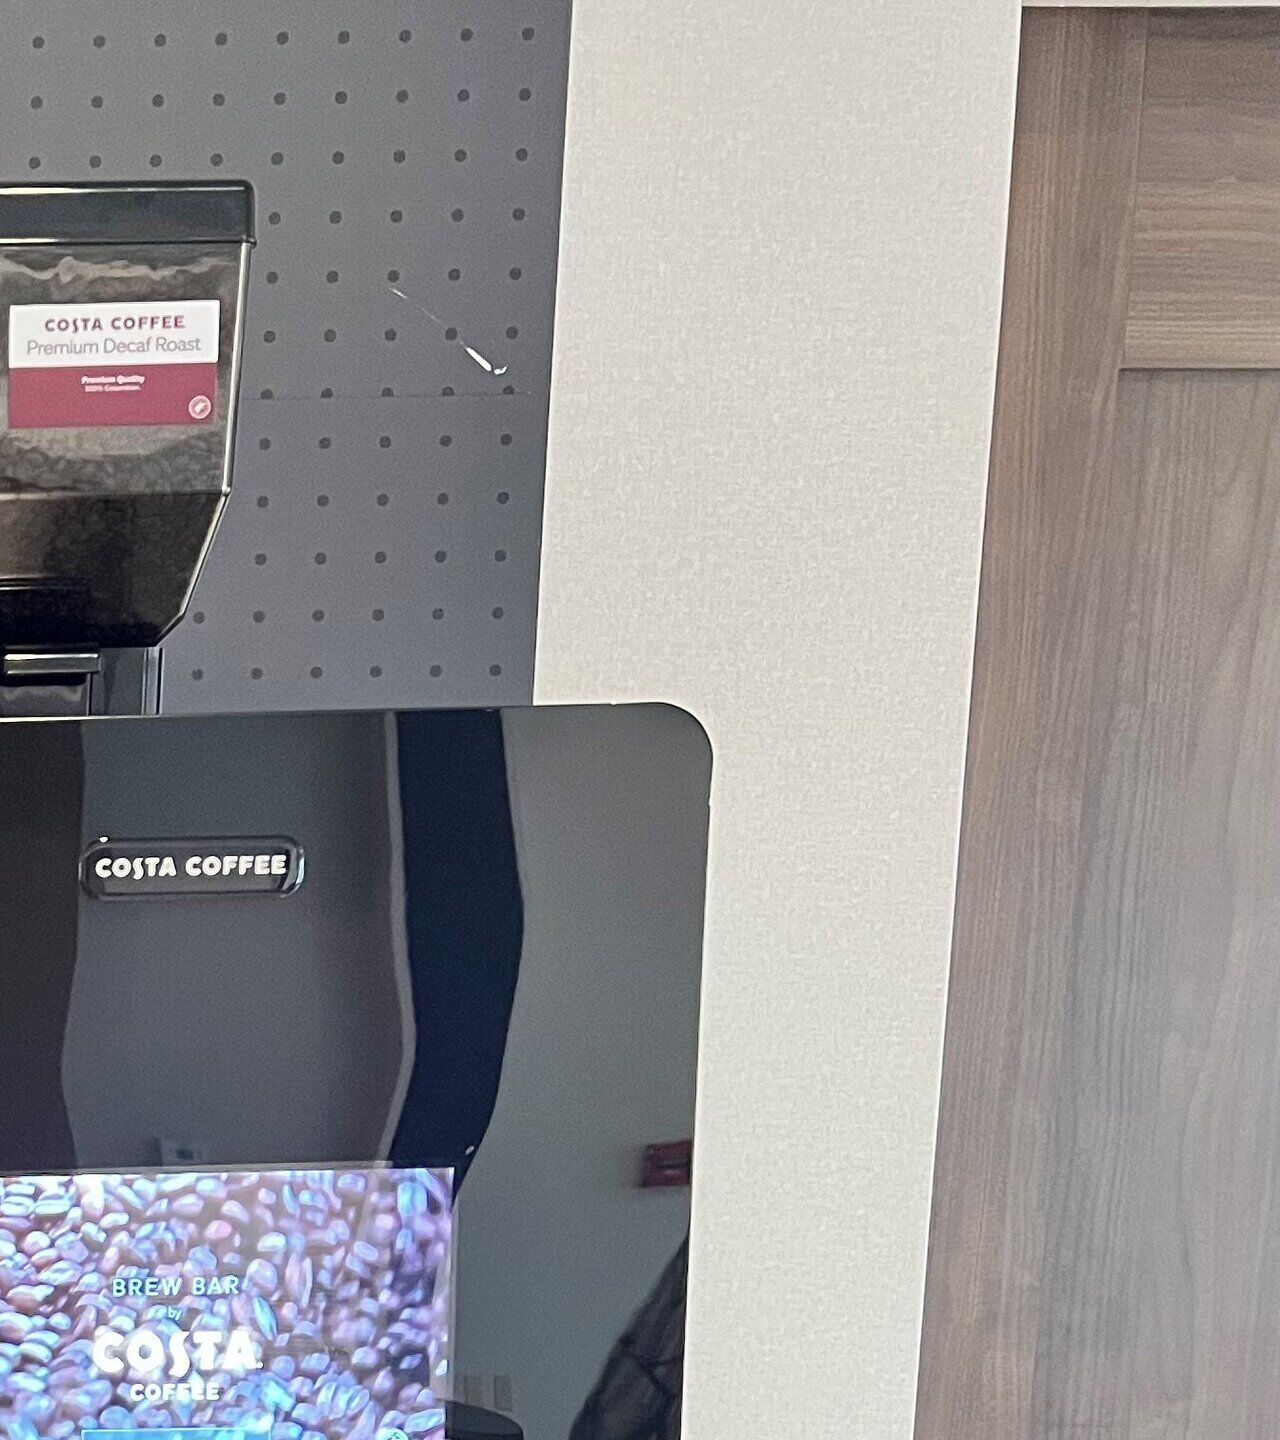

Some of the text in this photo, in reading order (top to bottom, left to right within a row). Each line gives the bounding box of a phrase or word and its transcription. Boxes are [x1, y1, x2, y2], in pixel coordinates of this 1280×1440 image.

[45, 315, 186, 334] COSTA COFFEE
[27, 336, 201, 356] Premium Decaf Roast
[95, 854, 287, 880] COSTA COFFEE
[112, 1274, 240, 1297] BREW BAR
[129, 1382, 220, 1401] COFFEE
